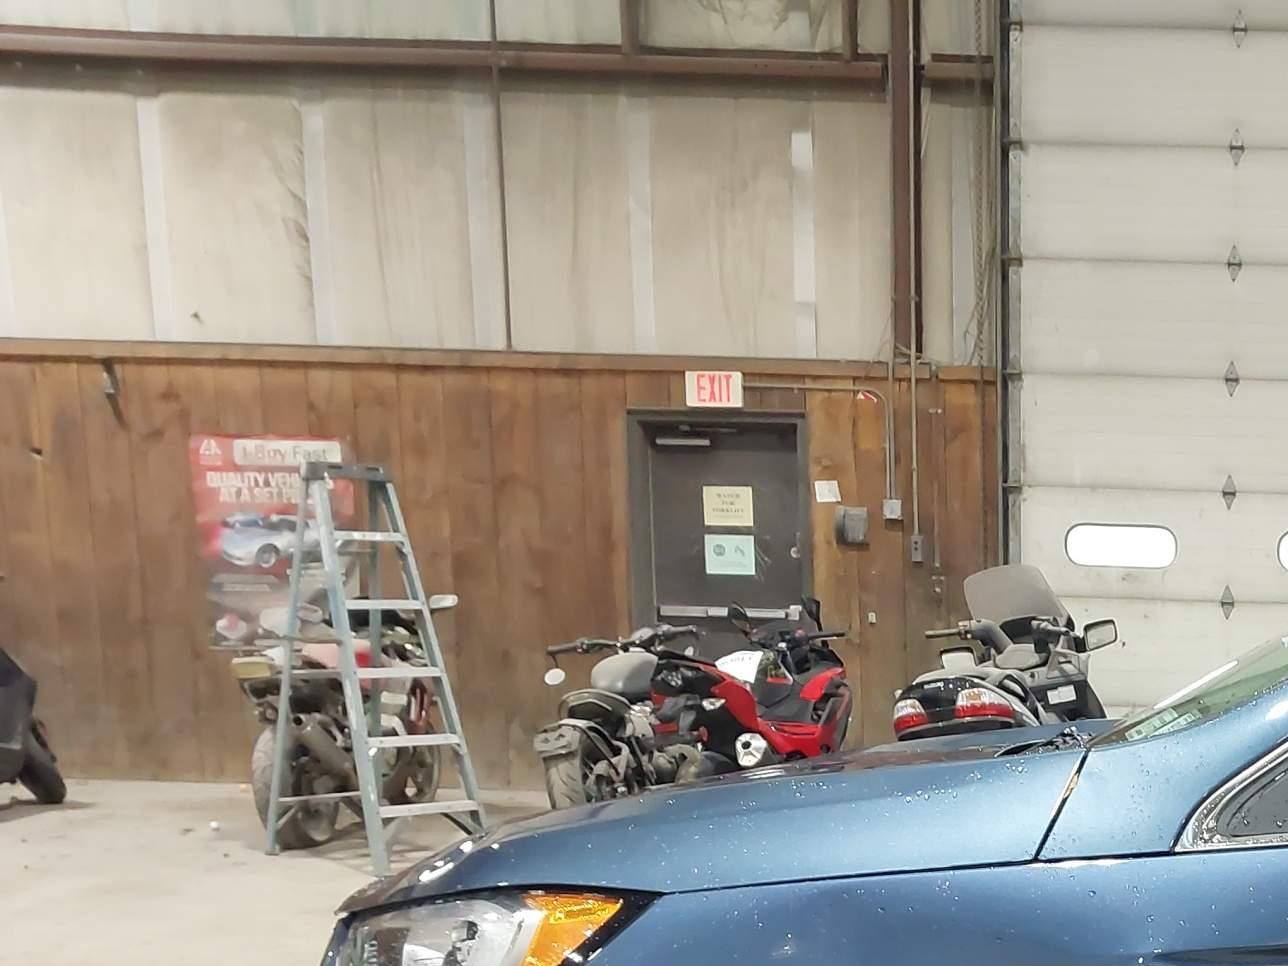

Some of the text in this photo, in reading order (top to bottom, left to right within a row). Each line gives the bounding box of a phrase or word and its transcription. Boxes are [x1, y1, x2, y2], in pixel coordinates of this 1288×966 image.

[696, 373, 732, 402] EXIT
[292, 445, 328, 461] Fast
[206, 471, 266, 488] QUALITY
[253, 488, 279, 504] SET
